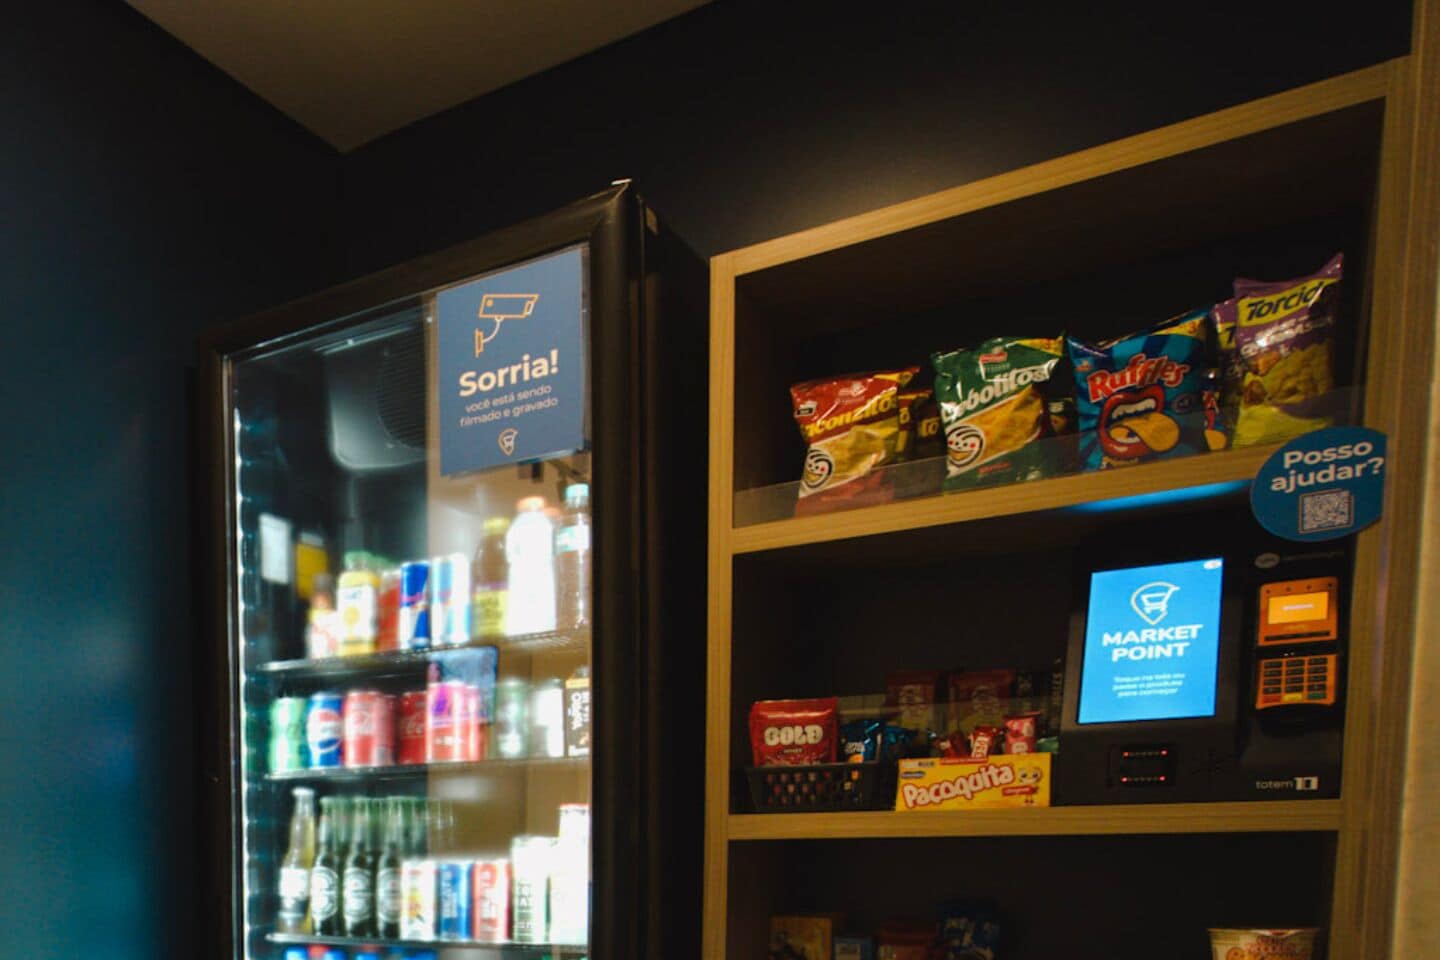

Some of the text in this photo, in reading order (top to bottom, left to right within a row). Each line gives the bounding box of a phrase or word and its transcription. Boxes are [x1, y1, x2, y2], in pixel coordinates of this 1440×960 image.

[459, 348, 559, 397] Sorria!
[1087, 352, 1191, 403] Ruffles
[460, 398, 558, 427] filmado e gravado
[465, 385, 552, 413] você está sendo
[1284, 441, 1373, 469] Posso
[1271, 457, 1384, 494] ajudar?
[1102, 624, 1203, 647] MARKET
[1111, 643, 1190, 662] POINT
[764, 725, 823, 746] GOLD
[1255, 779, 1293, 790] totem
